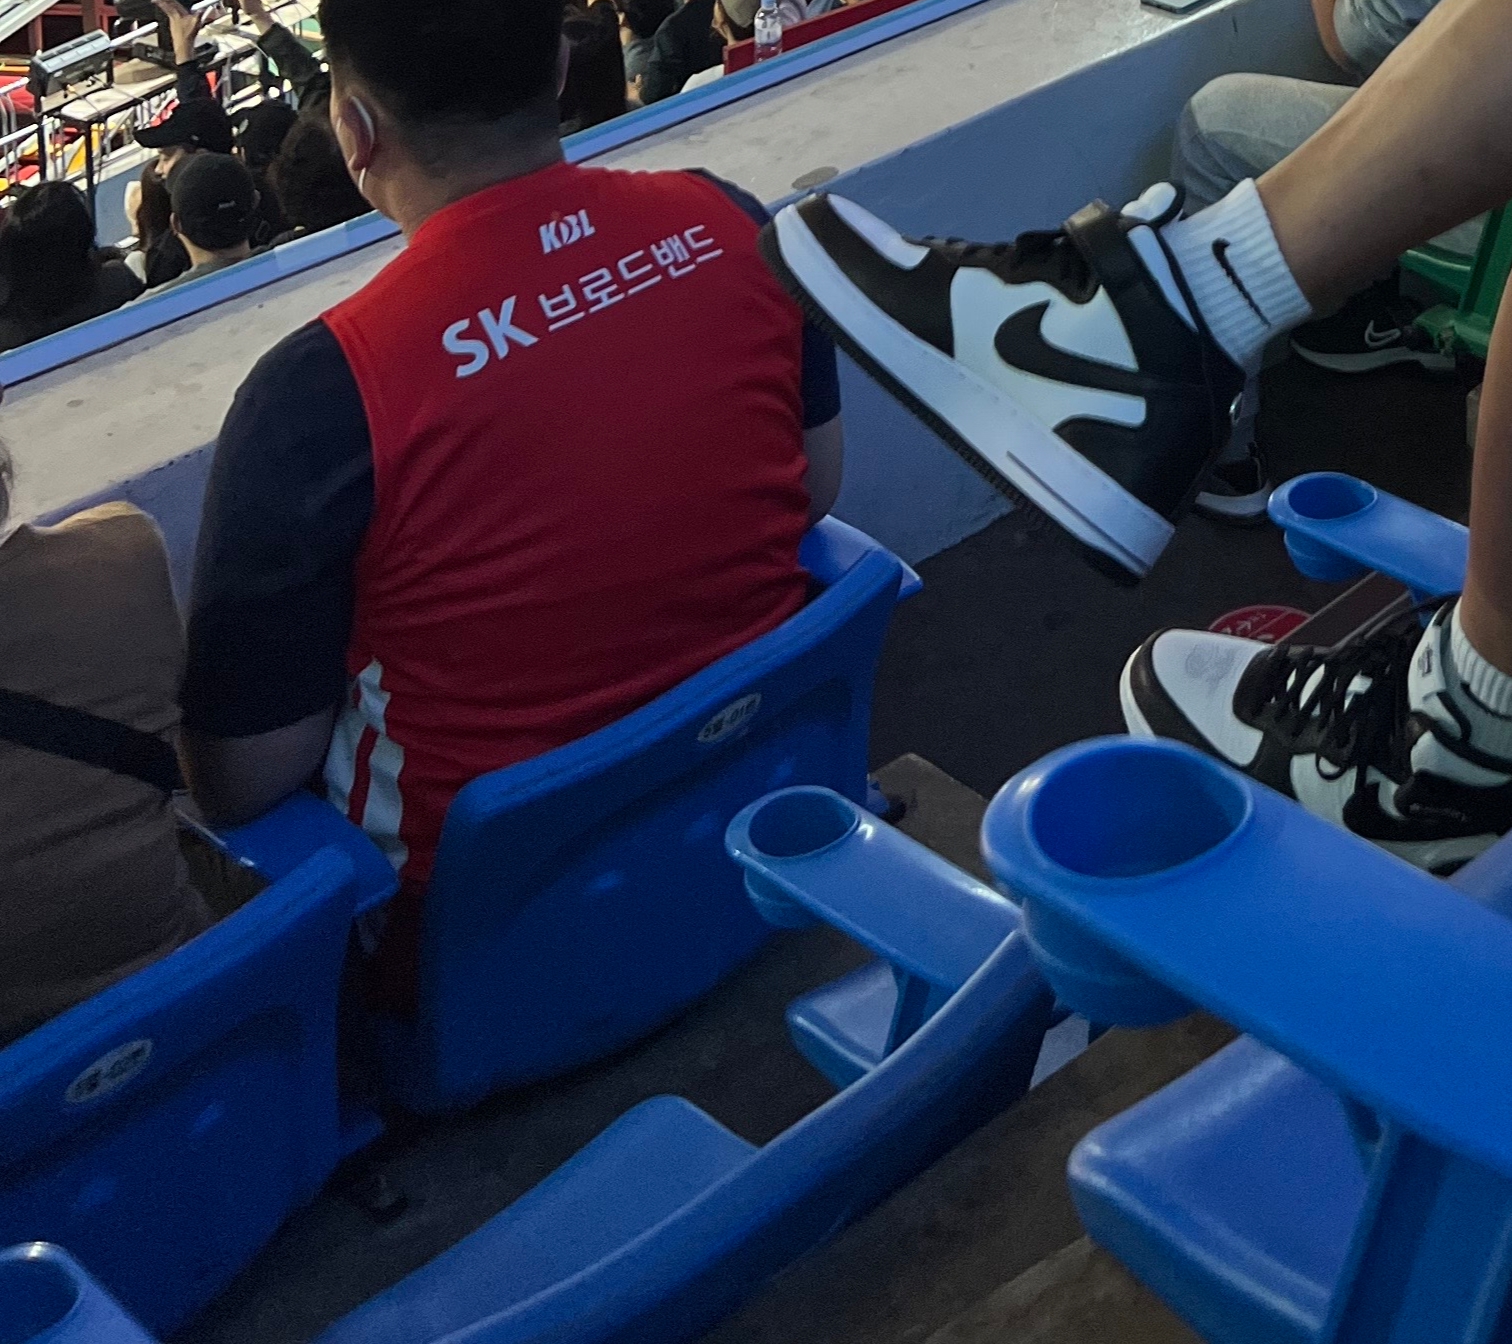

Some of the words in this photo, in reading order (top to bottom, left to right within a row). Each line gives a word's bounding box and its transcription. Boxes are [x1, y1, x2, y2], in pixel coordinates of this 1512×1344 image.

[538, 209, 596, 254] KBL
[442, 295, 539, 378] SK
[538, 224, 723, 332] 브로드밴드
